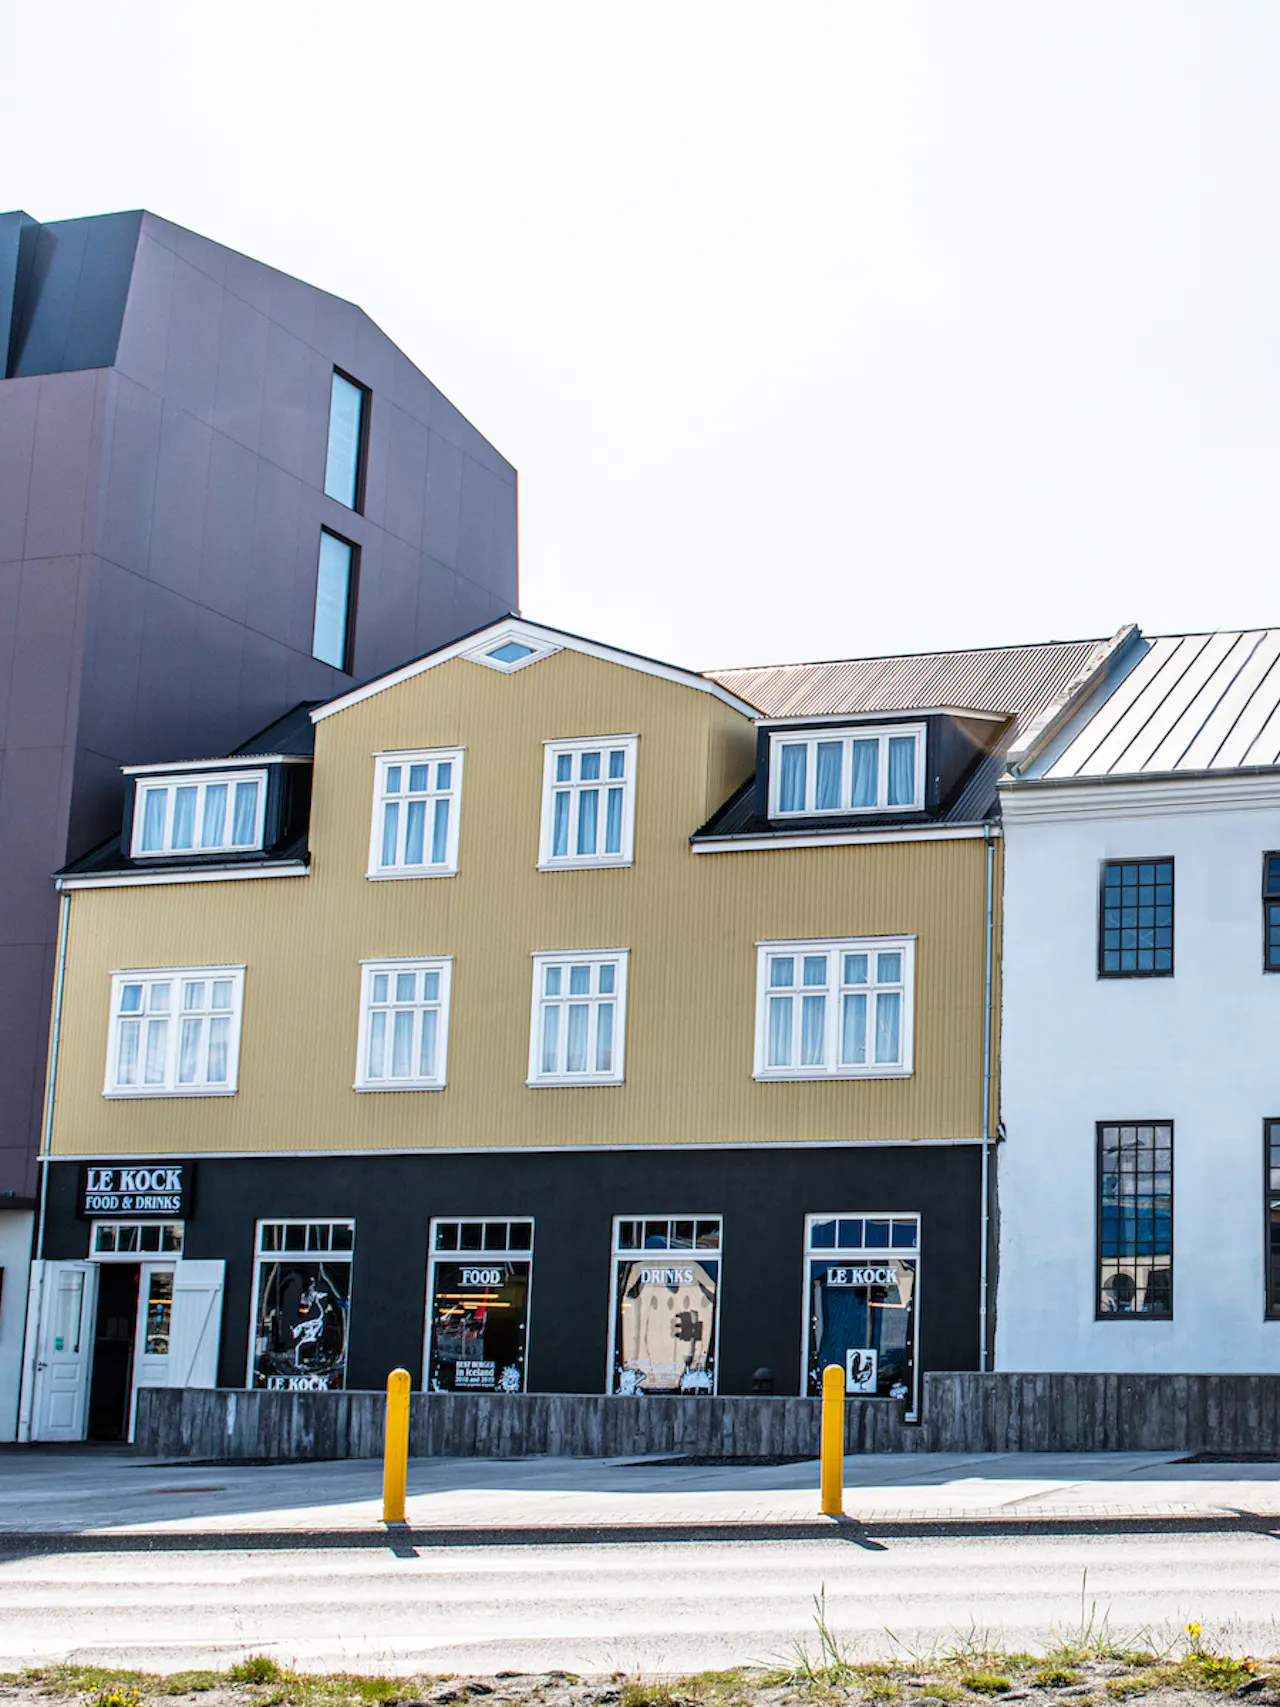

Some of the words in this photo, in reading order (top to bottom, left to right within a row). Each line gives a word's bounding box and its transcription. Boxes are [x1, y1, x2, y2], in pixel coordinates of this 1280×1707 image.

[86, 1170, 113, 1191] LE
[119, 1169, 182, 1191] KOCK
[85, 1196, 119, 1209] FOOD
[122, 1196, 133, 1209] &
[135, 1196, 180, 1209] DRINKS
[462, 1269, 501, 1284] FOOD
[640, 1269, 694, 1283] DRINKS
[826, 1269, 847, 1283] LE
[851, 1269, 898, 1283] KOCK
[465, 1368, 495, 1376] Iceland
[267, 1377, 285, 1391] LE
[288, 1377, 329, 1391] KOCK
